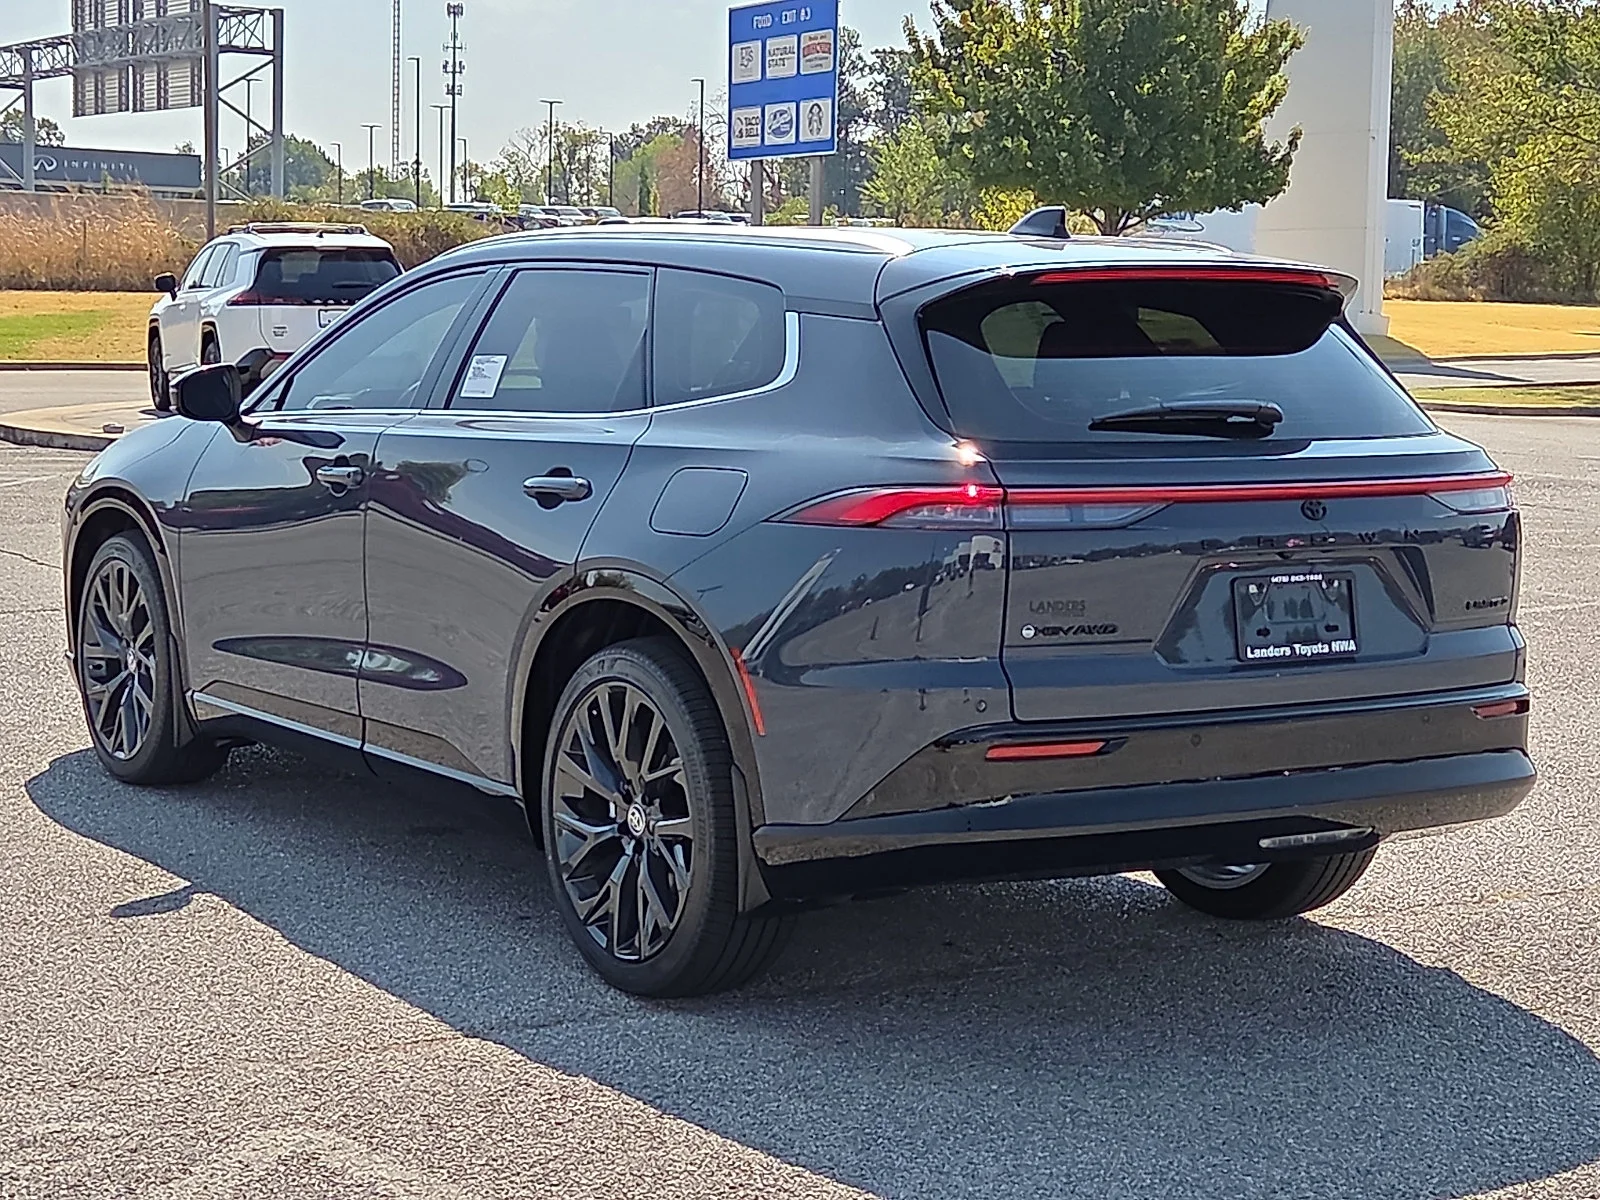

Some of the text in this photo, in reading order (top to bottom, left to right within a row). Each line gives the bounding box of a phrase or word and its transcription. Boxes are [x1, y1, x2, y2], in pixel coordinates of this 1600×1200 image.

[768, 46, 796, 58] NATURAL
[745, 116, 760, 127] TACO
[745, 127, 760, 138] BELL
[64, 159, 134, 172] INFINITI
[1029, 600, 1086, 614] LANDERS
[1246, 639, 1357, 659] Landers Toyota NWA
